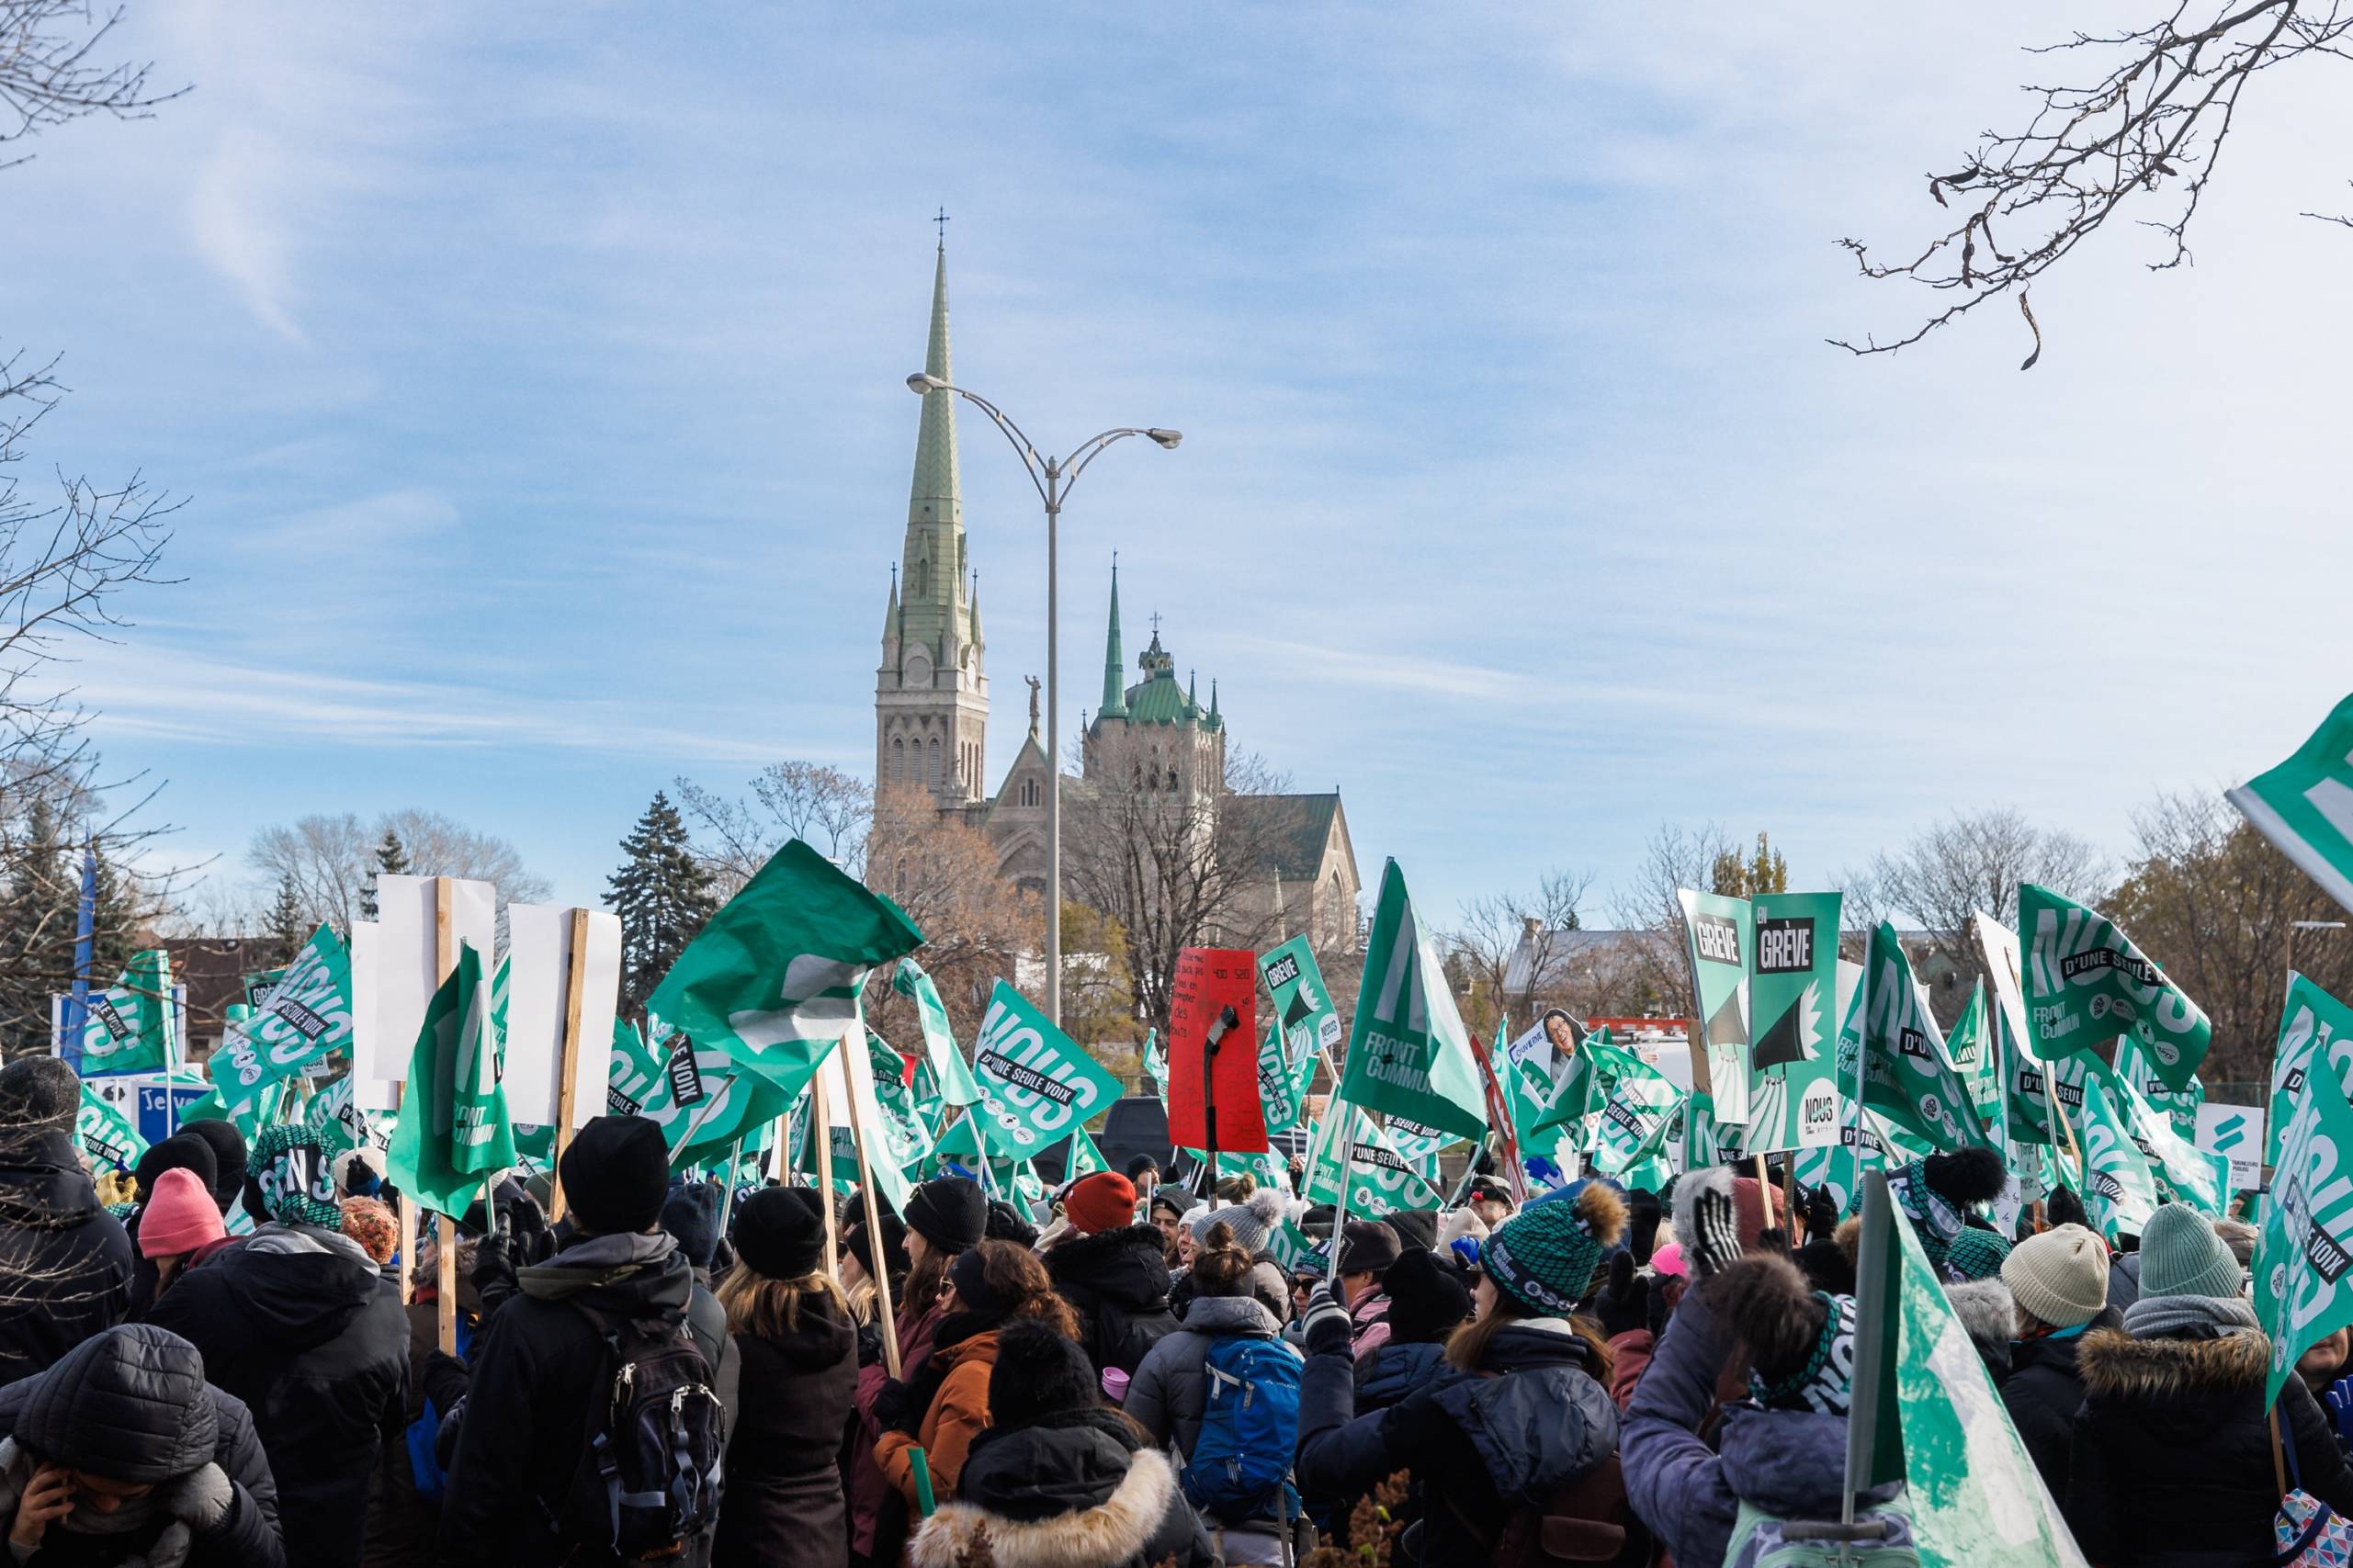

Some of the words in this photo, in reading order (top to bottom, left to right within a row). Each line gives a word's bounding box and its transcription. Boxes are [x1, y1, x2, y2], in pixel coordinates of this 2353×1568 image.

[1757, 907, 1768, 924] EN
[1696, 917, 1739, 963] GRÈVE
[1760, 920, 1810, 968] GRÈVE
[1267, 958, 1298, 987] GRÈVE
[2065, 951, 2108, 976] D'UNE
[2112, 954, 2152, 982] SEULE
[106, 1013, 126, 1038] VOIX
[303, 1014, 325, 1037] VOIX
[2033, 1001, 2066, 1024] FRONT
[1363, 1031, 1420, 1066] FRONT
[976, 999, 1098, 1131] NOUS
[673, 1060, 698, 1101] VOIX
[981, 1055, 1013, 1077] D'UNE
[1012, 1066, 1045, 1092] SEULE
[1045, 1080, 1072, 1102] VOIX
[2023, 1076, 2044, 1091] D'U
[2057, 1085, 2082, 1103] SEUL
[141, 1089, 165, 1111] Je
[607, 1089, 631, 1112] SEULE
[1805, 1097, 1834, 1123] NOUS
[1394, 1117, 1421, 1133] SEULE
[1607, 1102, 1630, 1126] SEULE
[1377, 1152, 1405, 1169] SEULE
[2310, 1236, 2346, 1277] VOIX
